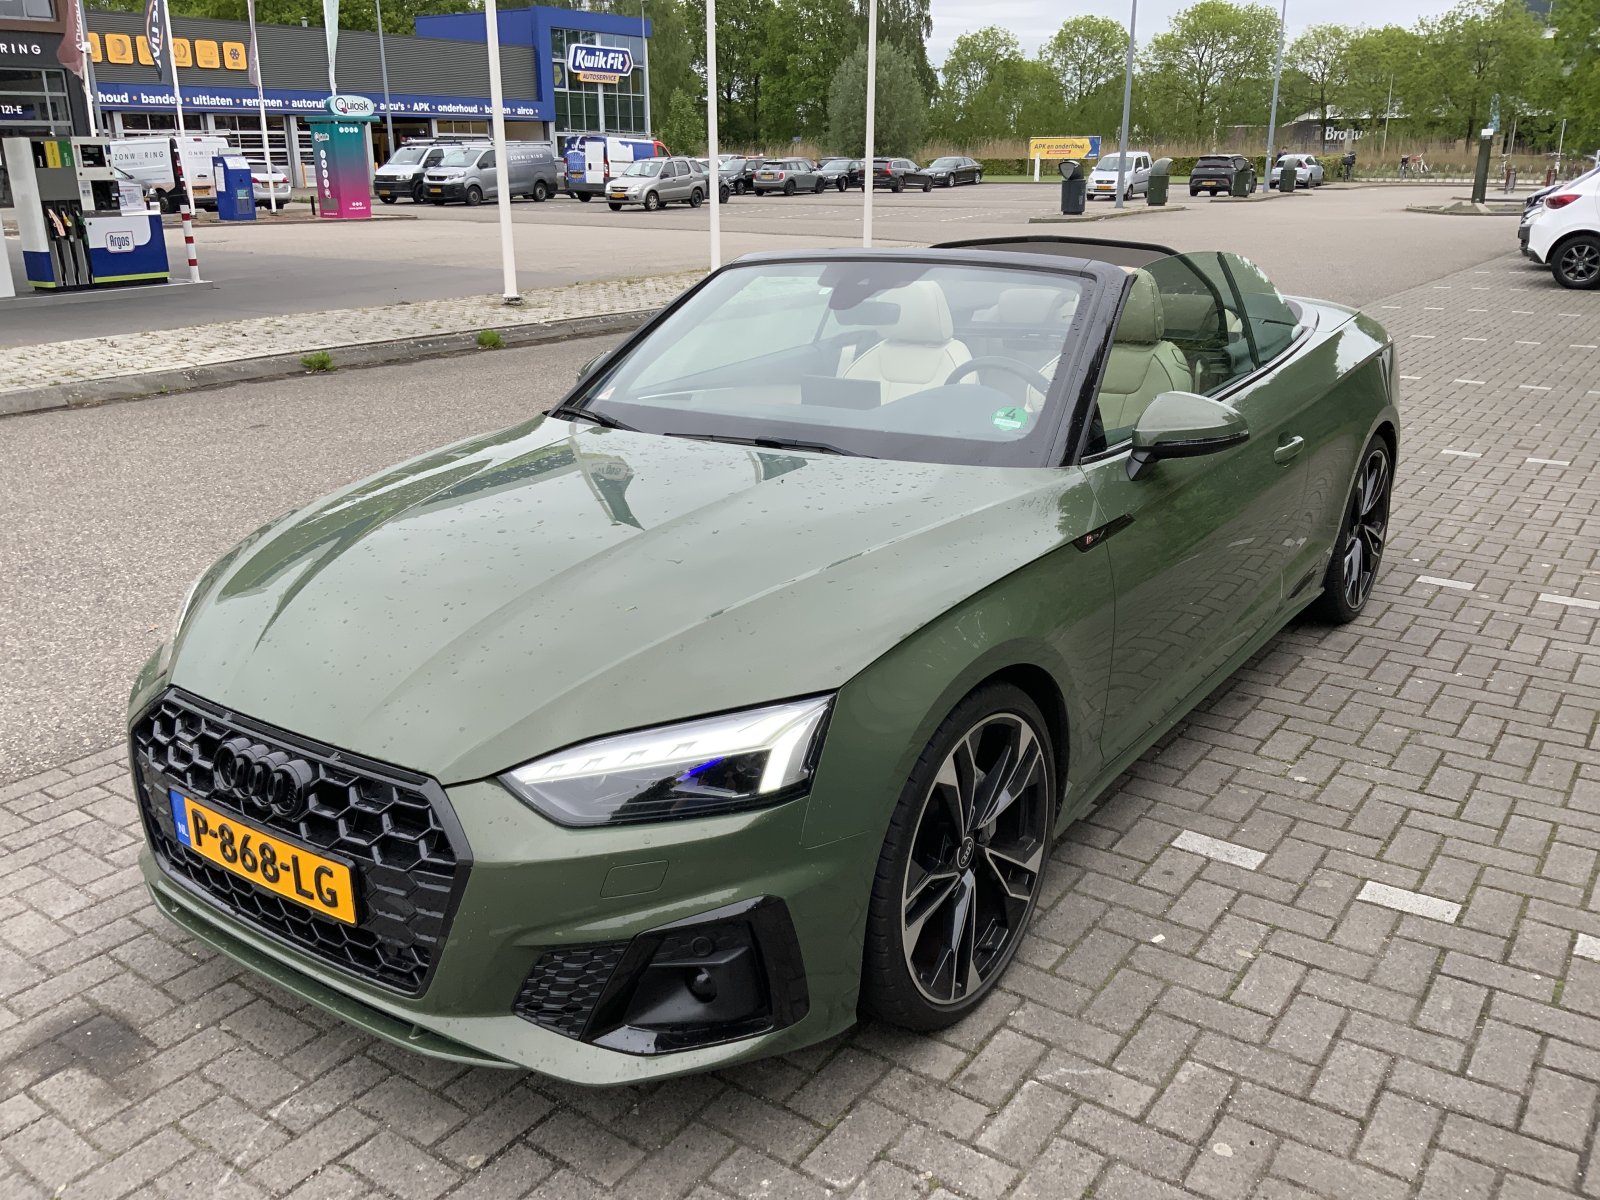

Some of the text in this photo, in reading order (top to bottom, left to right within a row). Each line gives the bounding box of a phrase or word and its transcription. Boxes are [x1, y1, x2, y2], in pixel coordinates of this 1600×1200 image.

[582, 73, 617, 82] AUTOSERVICE
[192, 94, 233, 106] uitlaten
[242, 98, 283, 107] remmen
[413, 102, 430, 111] APK
[437, 103, 478, 113] onderhoud
[484, 104, 511, 115] baen
[516, 106, 534, 115] airco
[335, 97, 369, 113] Quiosk
[109, 234, 130, 250] Argos
[177, 821, 189, 837] NL
[191, 808, 339, 908] P-868-LG
